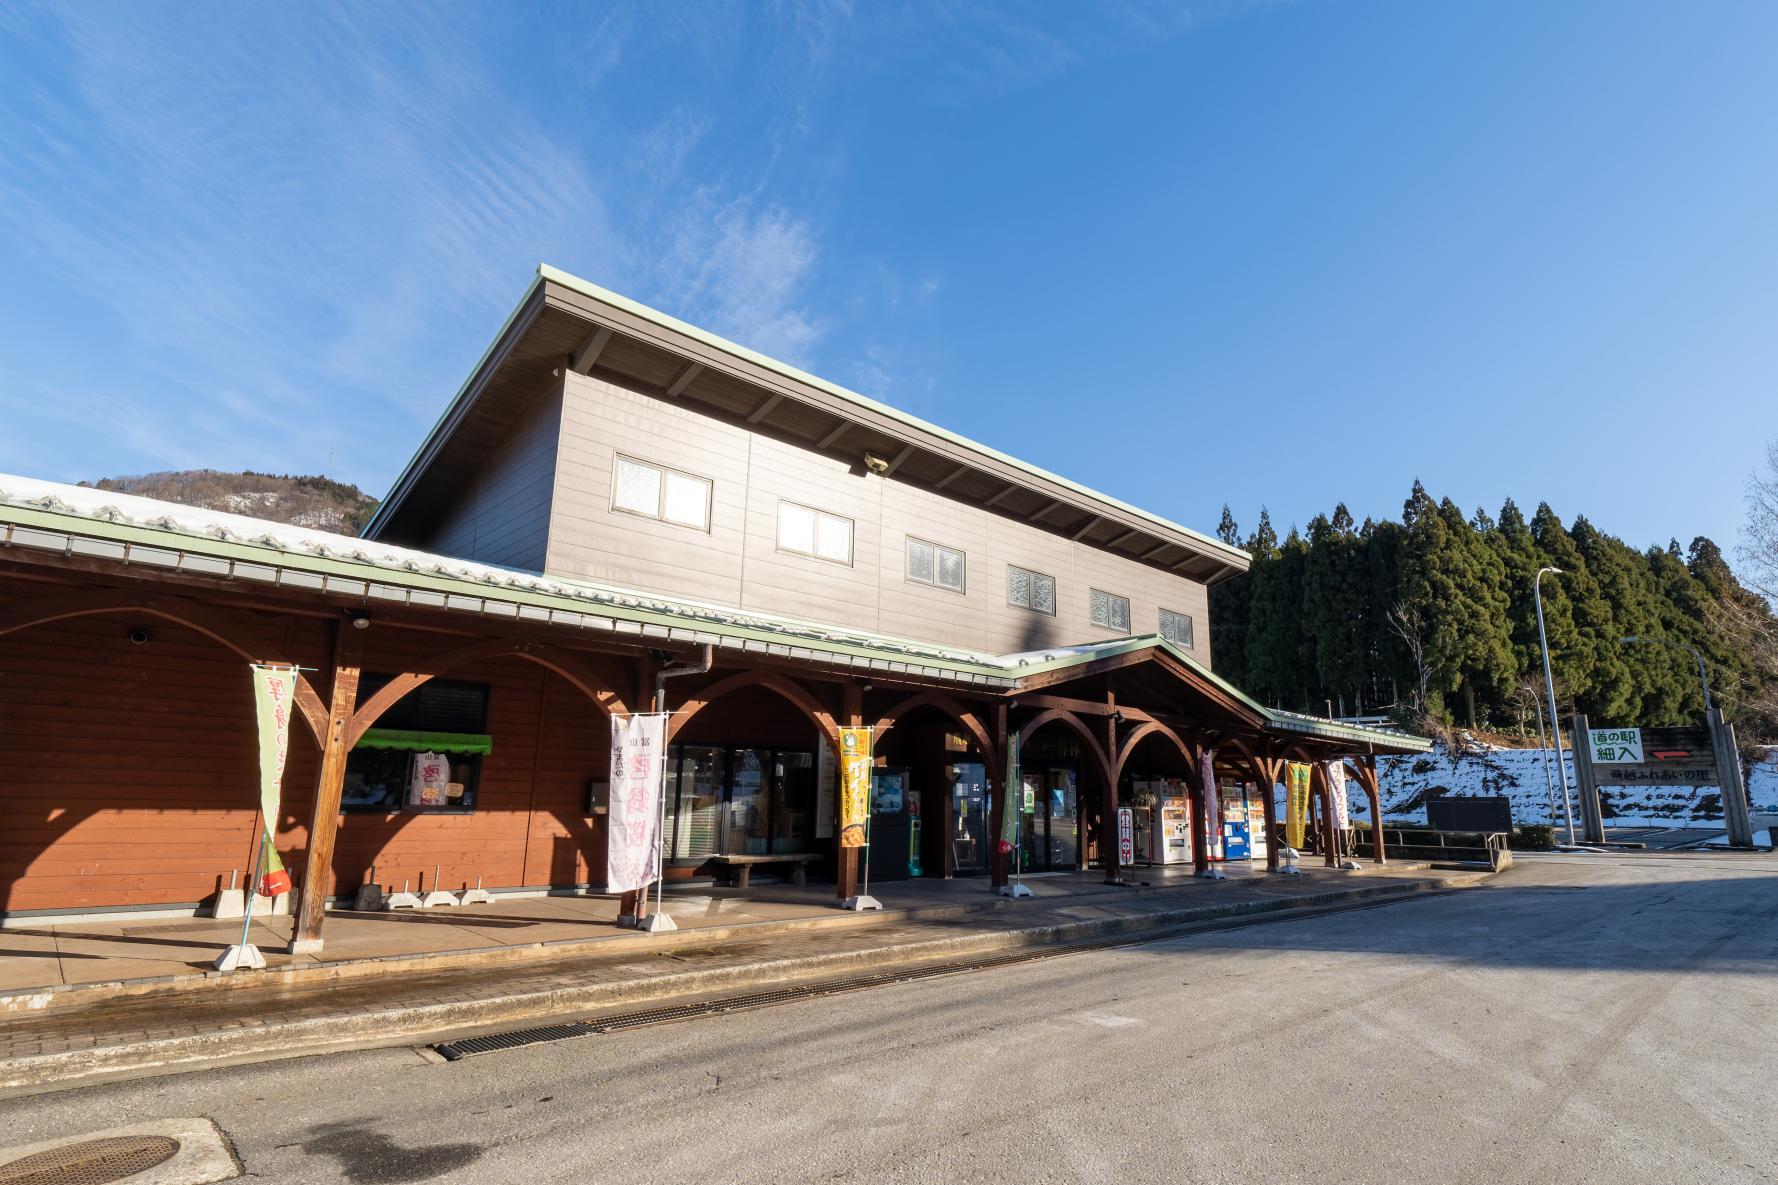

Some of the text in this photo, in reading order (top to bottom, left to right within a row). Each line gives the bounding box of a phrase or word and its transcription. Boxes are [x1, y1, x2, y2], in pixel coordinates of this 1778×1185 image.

[1592, 730, 1637, 745] 道の駅
[1597, 747, 1638, 761] 細入
